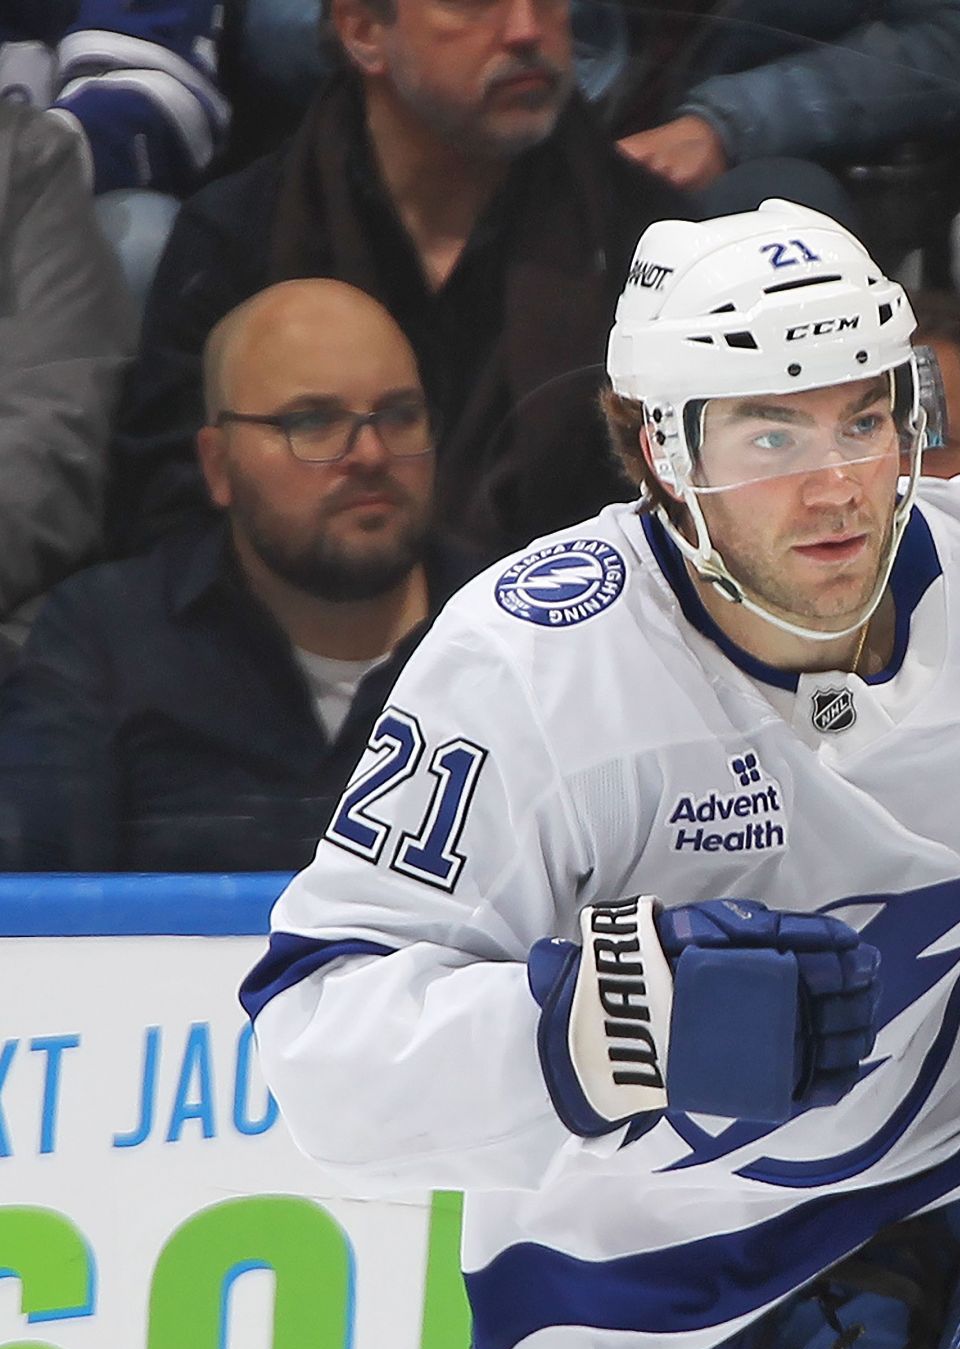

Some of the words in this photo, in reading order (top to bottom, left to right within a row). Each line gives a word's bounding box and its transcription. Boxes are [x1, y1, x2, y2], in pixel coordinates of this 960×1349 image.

[759, 239, 822, 271] 21
[786, 315, 860, 342] CCM
[503, 544, 566, 579] TAMPA
[572, 540, 610, 554] BAY
[549, 555, 621, 623] LIGHTNING
[820, 698, 849, 727] NHL
[324, 704, 490, 895] 21
[669, 785, 780, 824] Advent
[674, 820, 785, 852] Health
